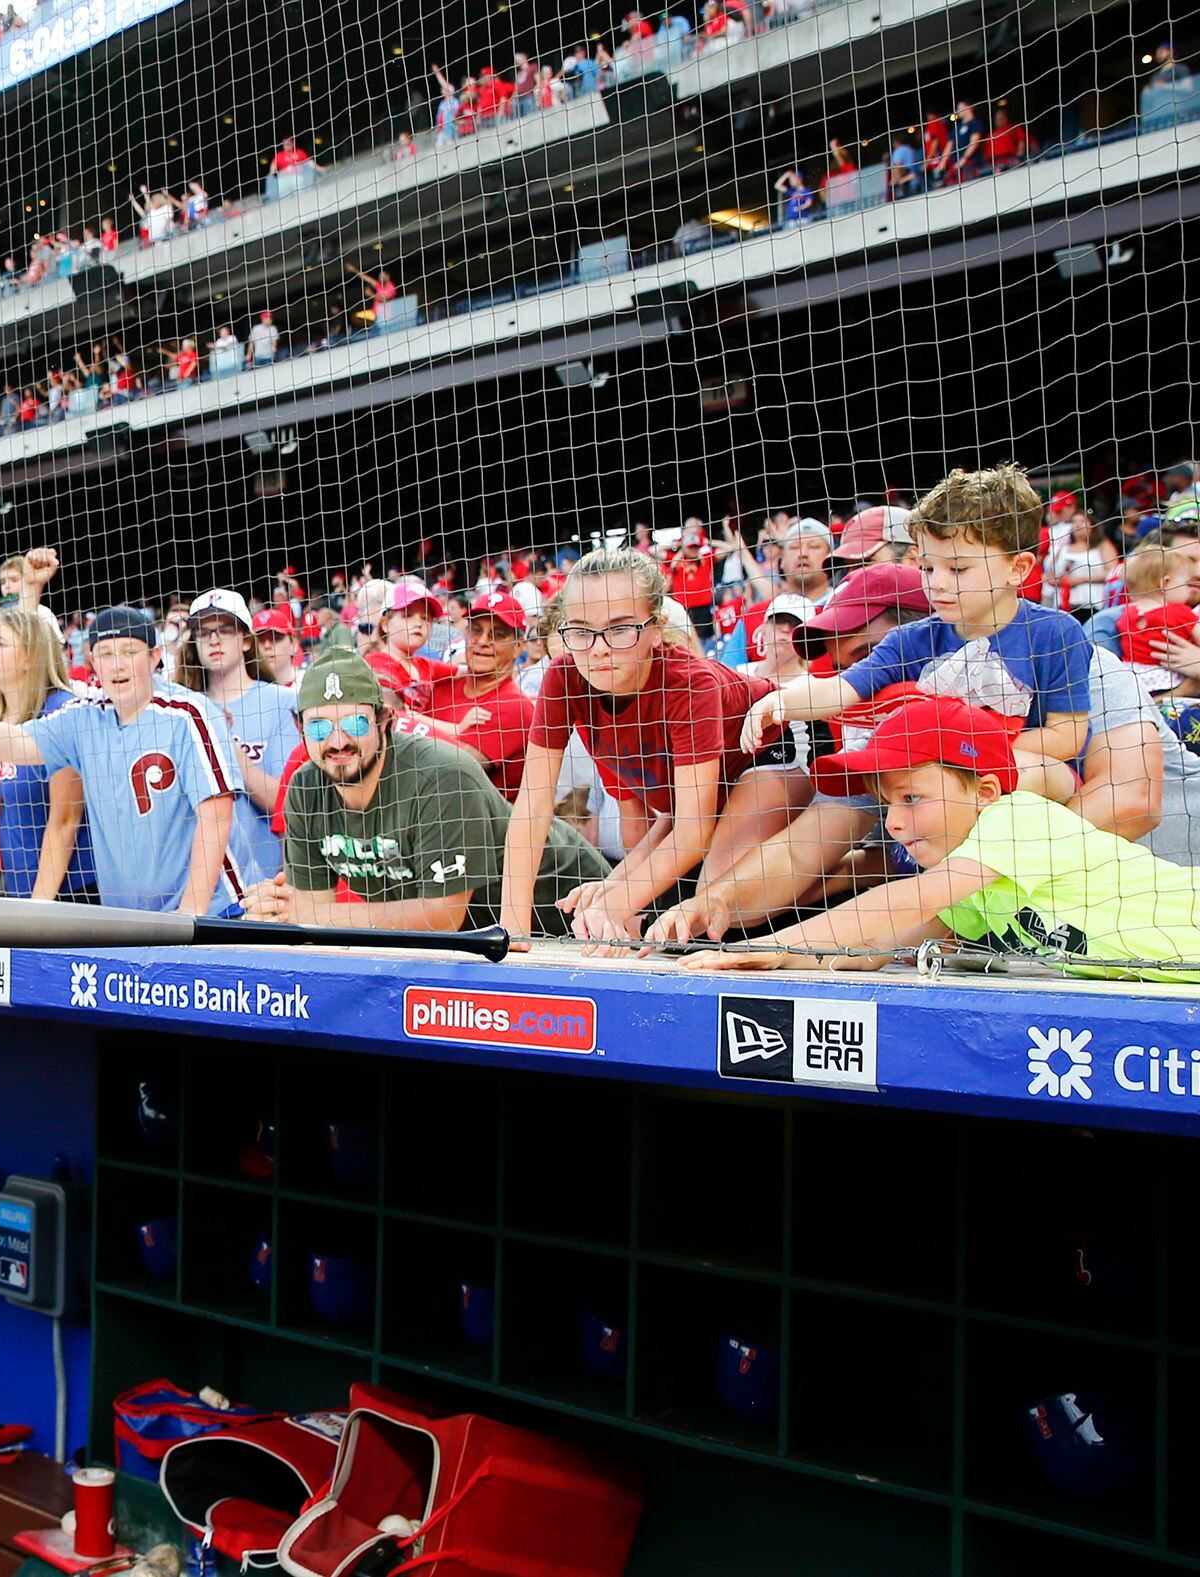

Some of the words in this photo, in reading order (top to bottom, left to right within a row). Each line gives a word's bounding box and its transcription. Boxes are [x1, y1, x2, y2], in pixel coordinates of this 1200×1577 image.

[105, 972, 189, 1009] Citizens
[194, 979, 249, 1015] Bank
[257, 980, 310, 1020] Park
[412, 998, 586, 1039] phillies.com
[806, 1018, 864, 1046] NEW
[806, 1045, 864, 1073] ERA
[1113, 1044, 1200, 1096] Citi
